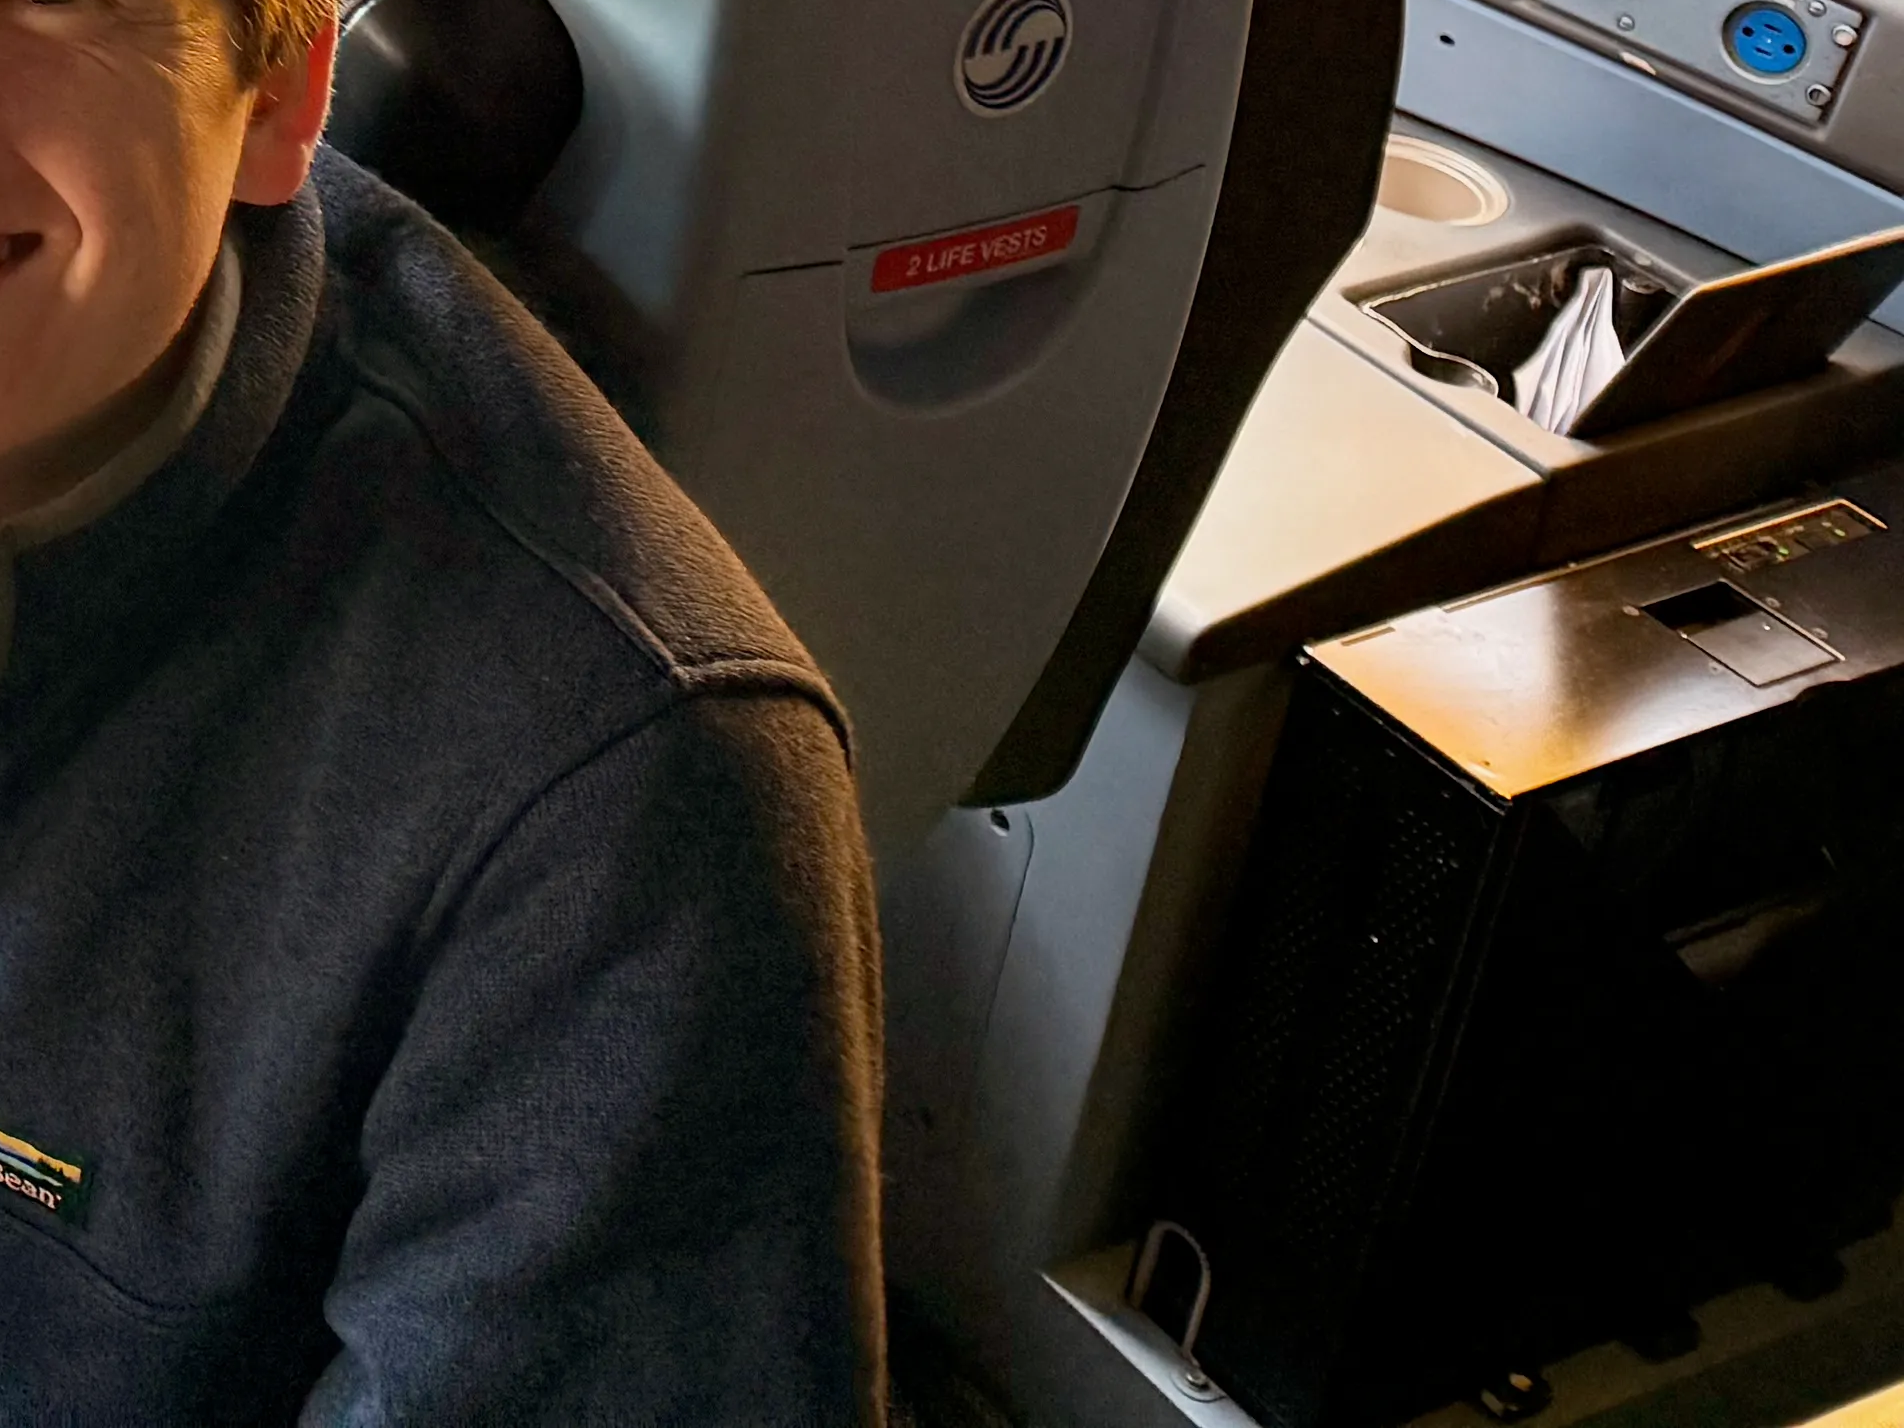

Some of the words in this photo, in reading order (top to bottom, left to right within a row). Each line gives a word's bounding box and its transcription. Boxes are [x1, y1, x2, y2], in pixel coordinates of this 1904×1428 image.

[905, 254, 921, 278] 2
[926, 240, 976, 274] LIFE
[978, 225, 1048, 262] VESTS
